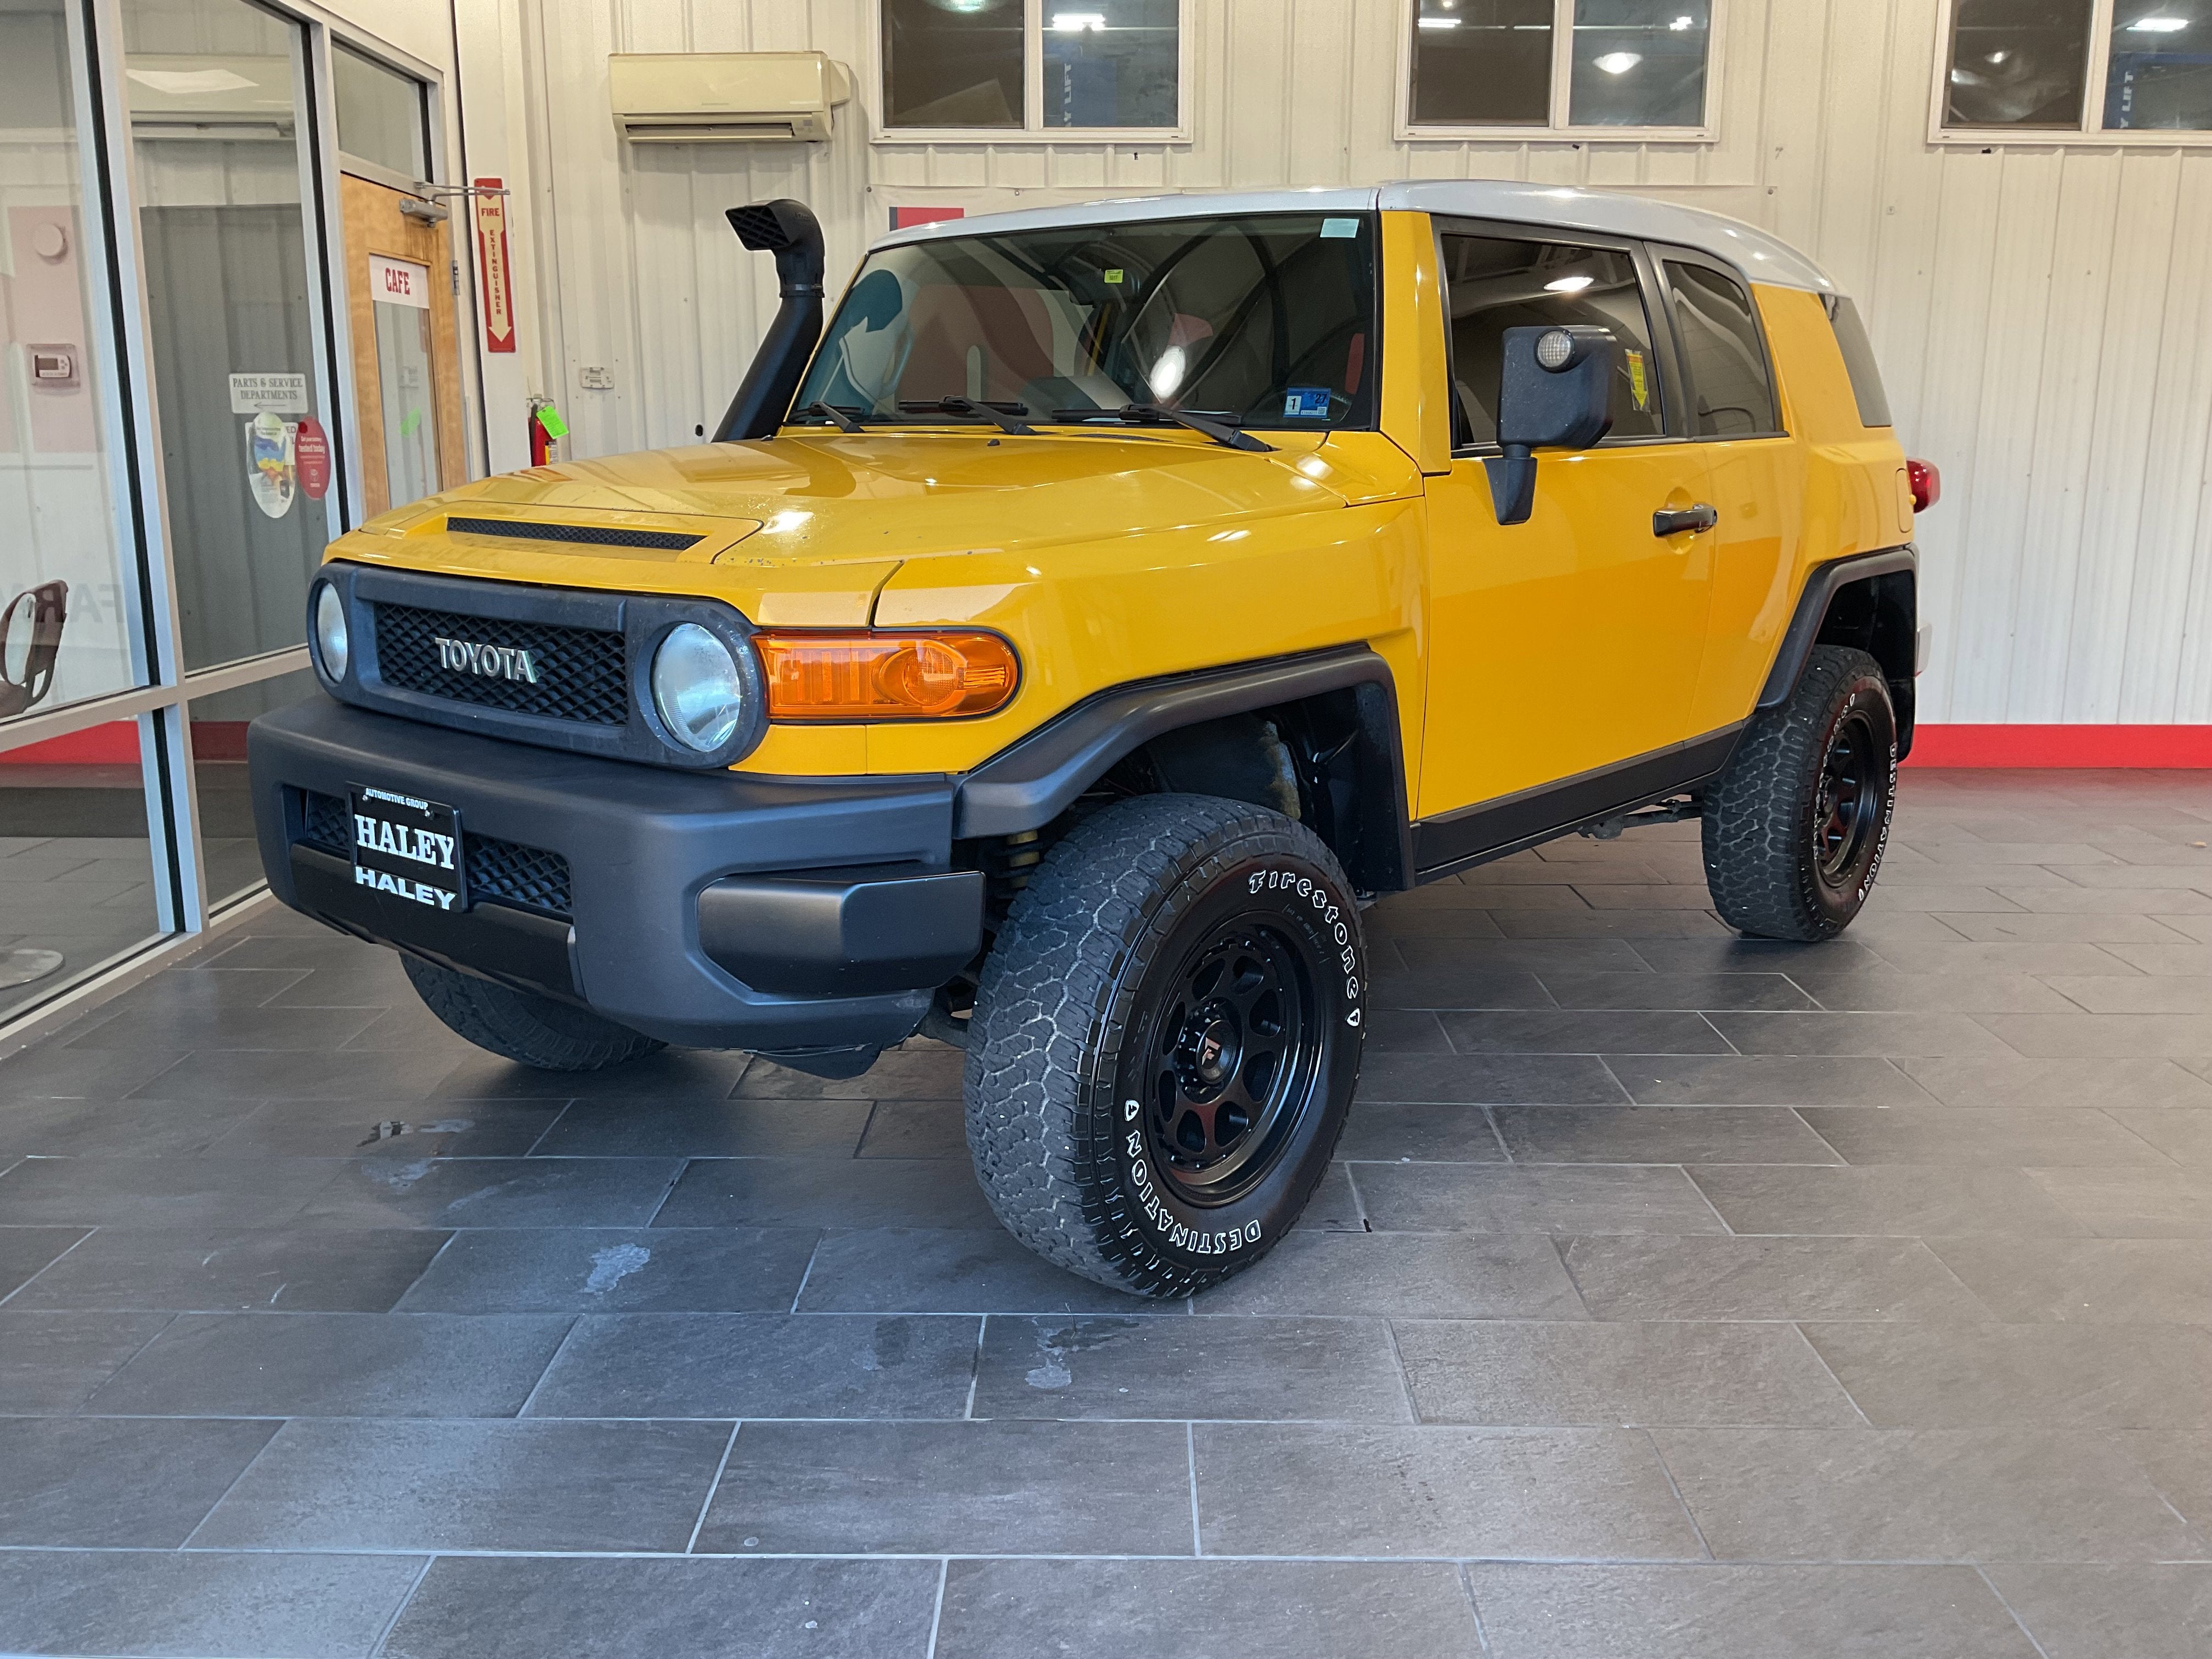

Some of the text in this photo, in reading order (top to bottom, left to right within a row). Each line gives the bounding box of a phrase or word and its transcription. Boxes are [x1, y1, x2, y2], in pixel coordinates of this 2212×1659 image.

[2122, 71, 2134, 111] LIFT
[481, 208, 500, 216] FIRE
[385, 267, 410, 295] CAFE
[490, 229, 501, 315] EXTINGUISHER
[233, 378, 303, 387] PARTS & SERVICE
[240, 390, 297, 399] DEPARTMENTS
[1314, 393, 1327, 404] 27
[1291, 398, 1296, 410] 1
[435, 637, 537, 684] TOYOTA
[365, 787, 428, 810] AUTOMOTIVE GROUP
[354, 814, 454, 870] HALEY
[355, 866, 456, 910] HALEY
[1249, 870, 1359, 1000] Firestone
[1125, 1129, 1262, 1255] DESTINATION
